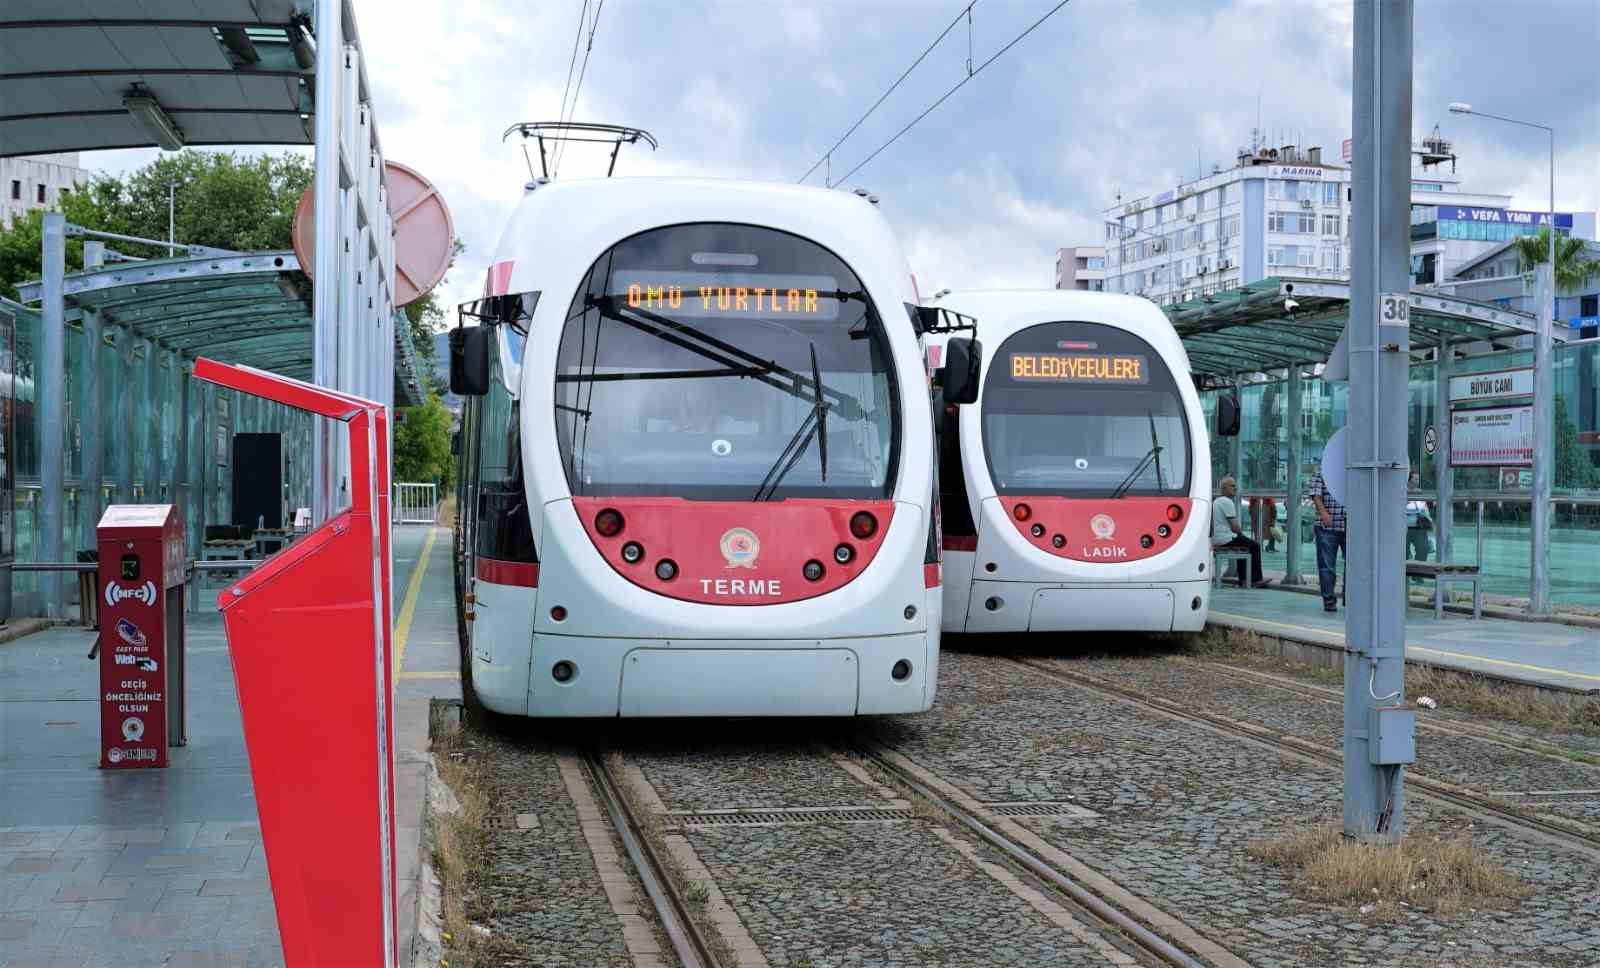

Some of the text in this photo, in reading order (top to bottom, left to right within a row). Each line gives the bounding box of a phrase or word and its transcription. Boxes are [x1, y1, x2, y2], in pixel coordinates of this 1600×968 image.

[1471, 210, 1500, 221] VEFA
[1506, 213, 1531, 223] YMM
[699, 287, 818, 313] YURTLAR
[1384, 298, 1407, 321] 38
[1470, 376, 1493, 394] BÜYÜK
[119, 589, 144, 598] NFC
[700, 579, 781, 595] TERME
[119, 704, 149, 713] OLSUN
